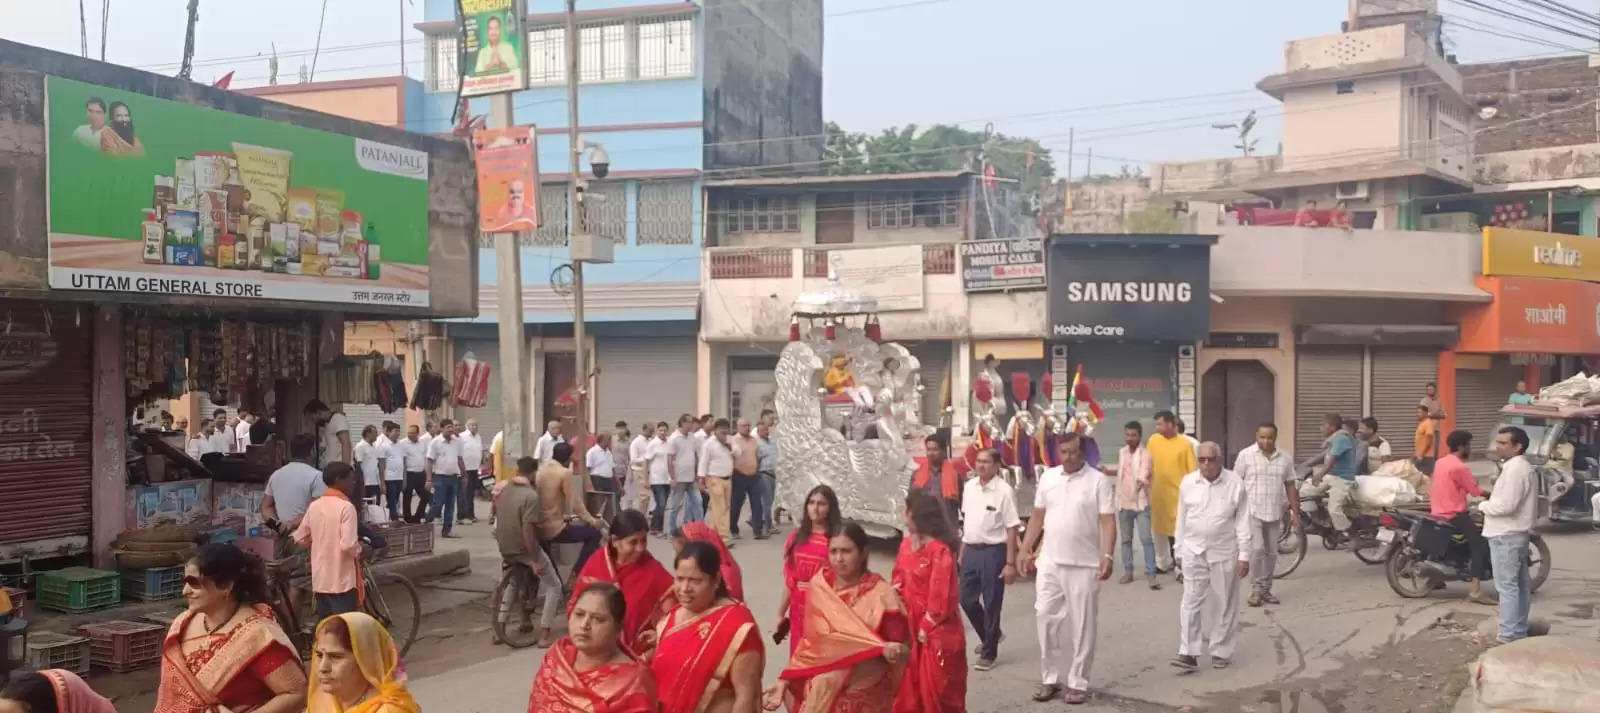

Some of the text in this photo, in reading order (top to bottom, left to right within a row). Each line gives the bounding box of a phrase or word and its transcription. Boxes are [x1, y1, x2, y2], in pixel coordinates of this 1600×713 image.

[961, 242, 1008, 255] PANDIYA
[971, 252, 1037, 266] MOBILE CARE
[71, 273, 263, 297] UTTAM GENERAL STORE
[1067, 281, 1192, 302] SAMSUNG
[1053, 323, 1125, 336] Mobile Care
